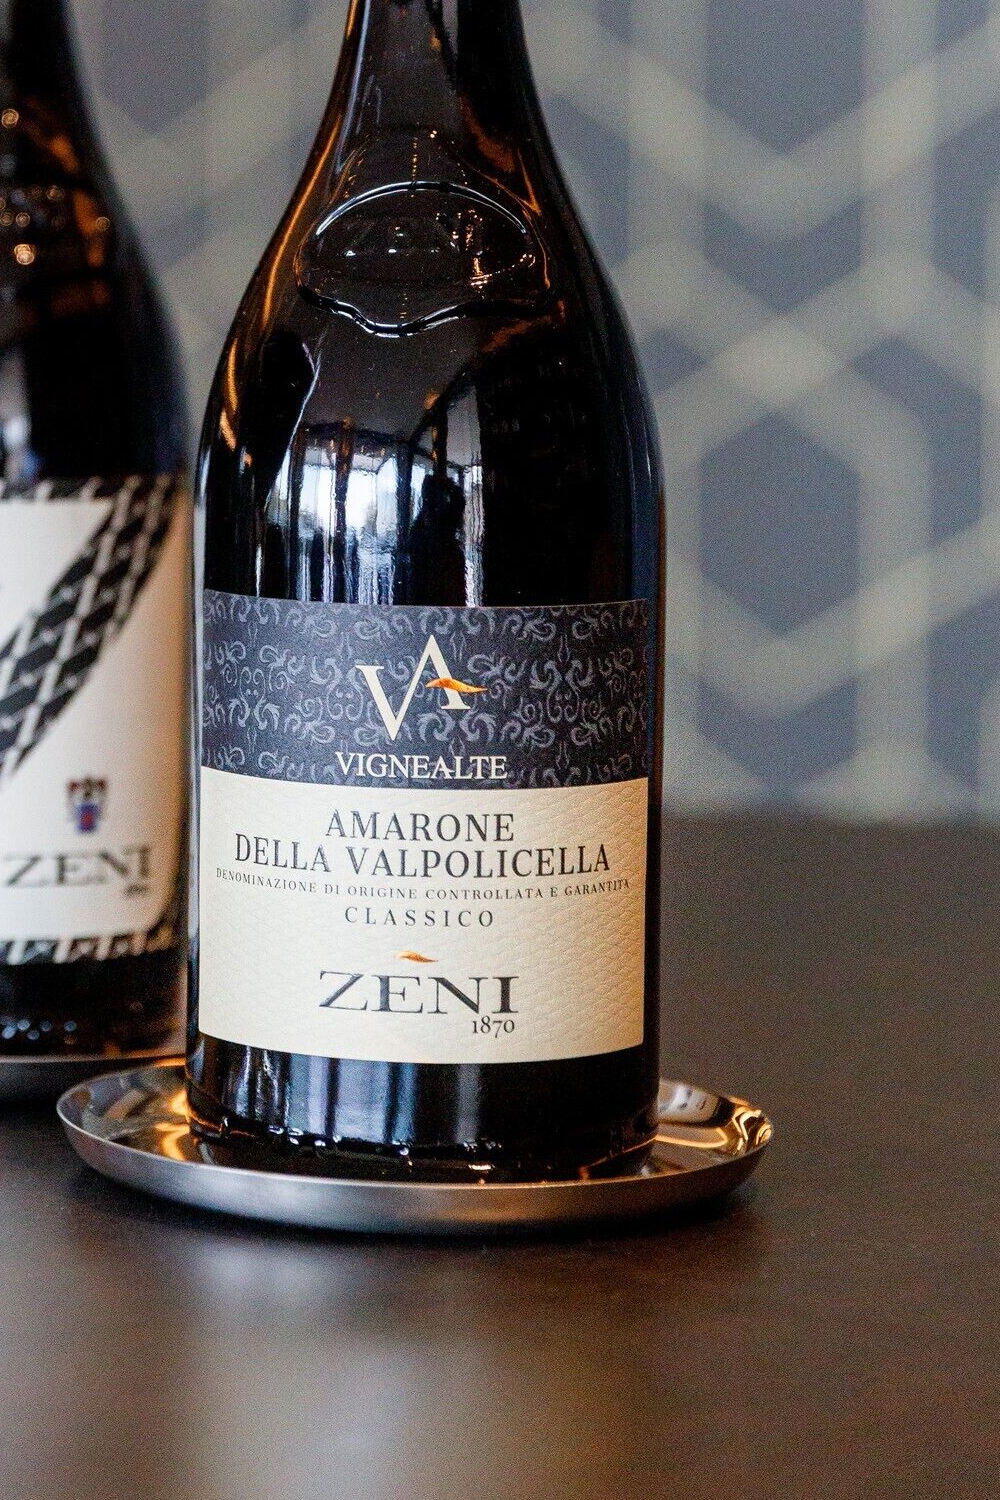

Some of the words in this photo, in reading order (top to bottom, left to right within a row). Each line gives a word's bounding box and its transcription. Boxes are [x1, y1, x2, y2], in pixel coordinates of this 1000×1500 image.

[335, 751, 508, 779] VIGNEALTE
[325, 809, 515, 843] AMARONE
[2, 844, 152, 888] ZENI
[234, 832, 331, 873] DELLA
[346, 843, 610, 879] VALPOLICELLA
[216, 867, 317, 894] DENOMINAZIONE
[324, 884, 341, 895] DI
[348, 885, 418, 900] ORIGINE
[425, 886, 544, 901] CONTROLLATA
[550, 887, 559, 898] E
[564, 878, 631, 897] GARANTITA
[344, 906, 495, 928] CLASSICO
[319, 970, 519, 1015] ZENI
[472, 1018, 516, 1038] 1870
